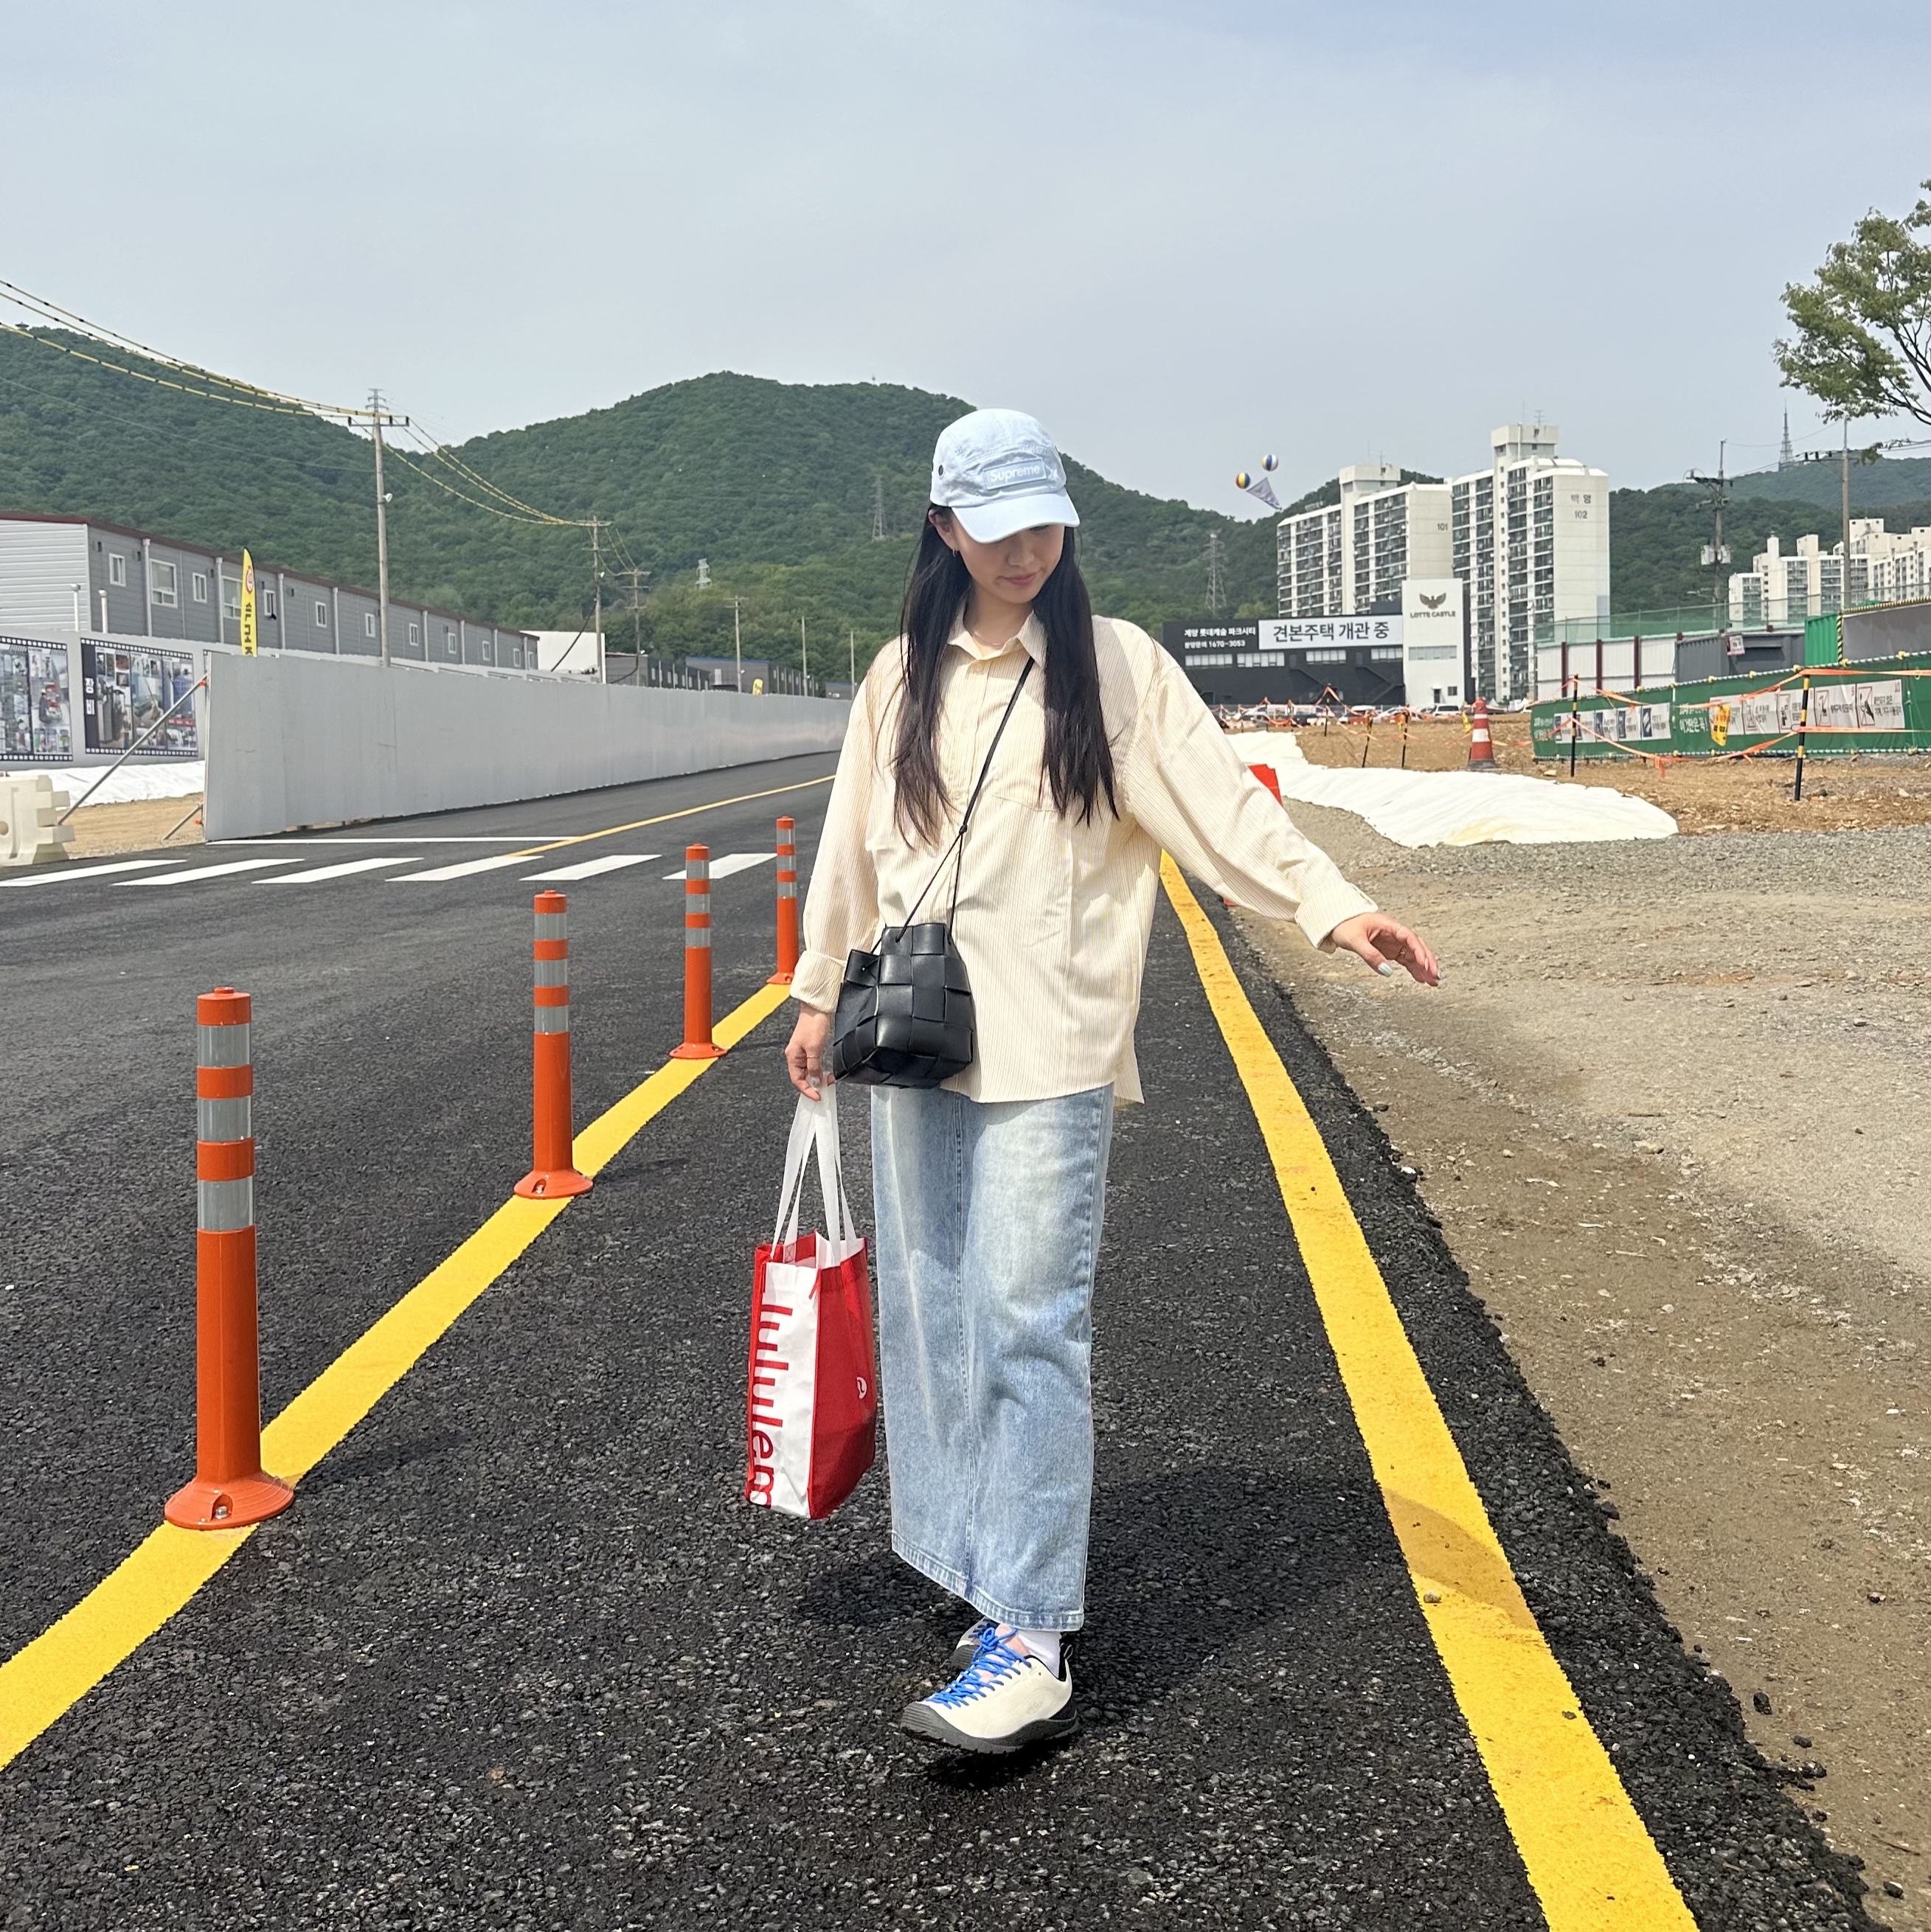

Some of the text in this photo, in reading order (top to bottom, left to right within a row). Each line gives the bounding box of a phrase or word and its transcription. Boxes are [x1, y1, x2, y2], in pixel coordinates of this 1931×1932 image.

[991, 465, 1040, 483] Supreme
[1575, 510, 1587, 519] 102
[1438, 523, 1448, 531] 101
[1228, 626, 1256, 636] 파크시티
[1273, 621, 1390, 642] 견본주택 개관 중
[1209, 639, 1246, 648] 1670-3053
